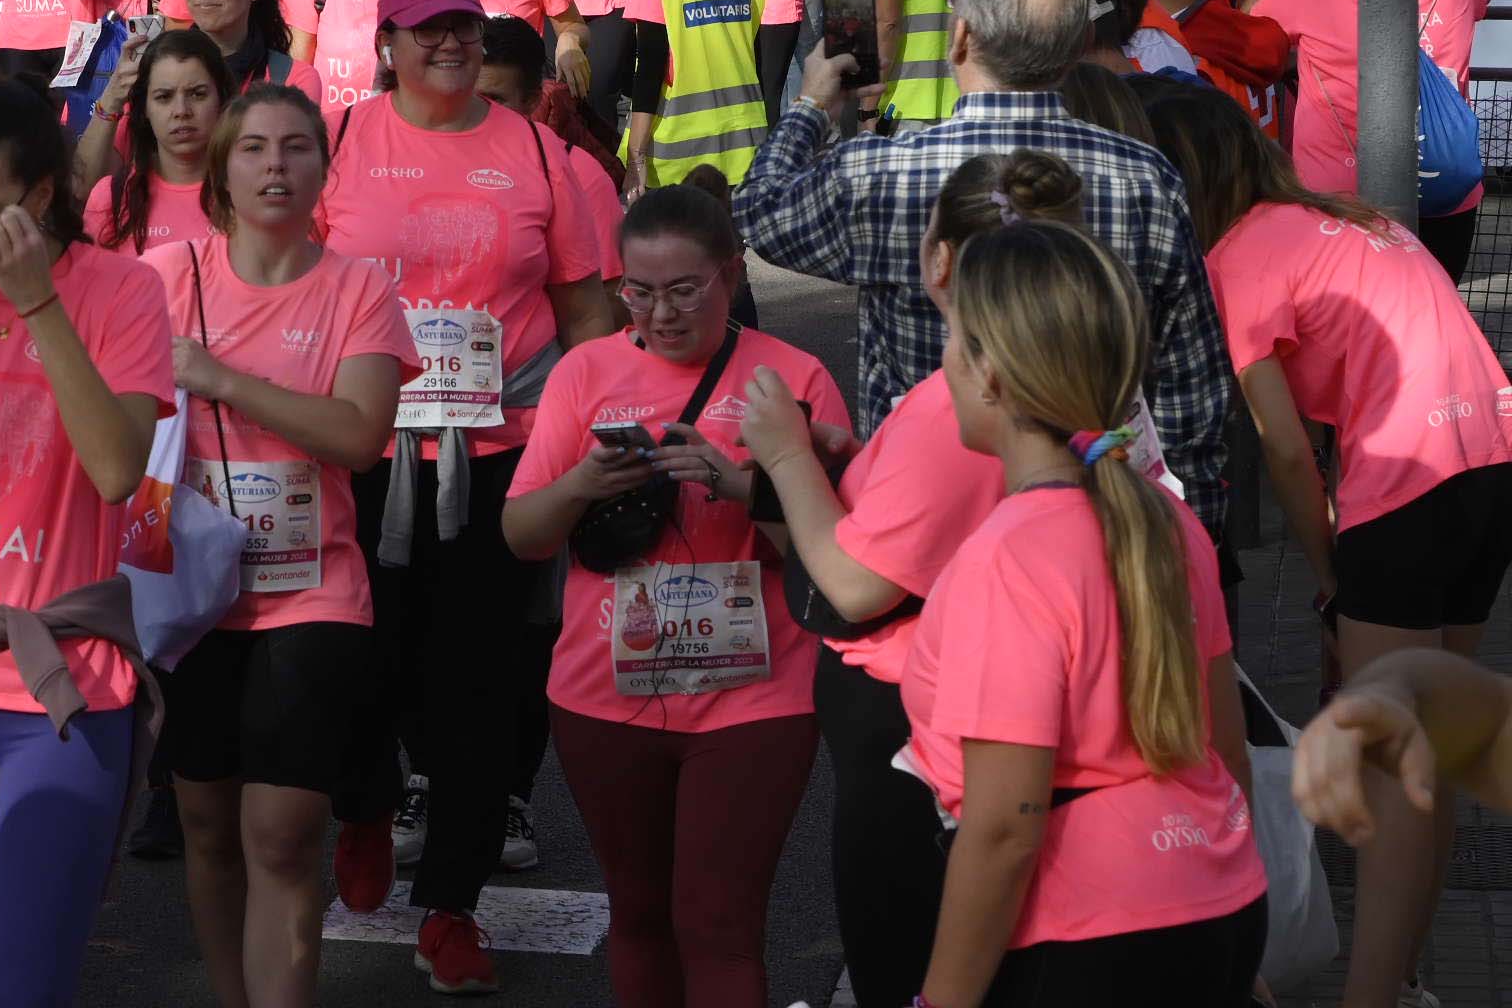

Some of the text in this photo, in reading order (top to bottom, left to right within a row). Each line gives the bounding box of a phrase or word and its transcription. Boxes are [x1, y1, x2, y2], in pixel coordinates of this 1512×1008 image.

[327, 58, 350, 78] TU
[369, 167, 424, 179] OYSHO
[415, 329, 465, 340] ASTURIANA
[420, 355, 462, 372] 016
[423, 377, 457, 388] 29166
[663, 618, 714, 638] 016
[669, 642, 710, 654] 19756
